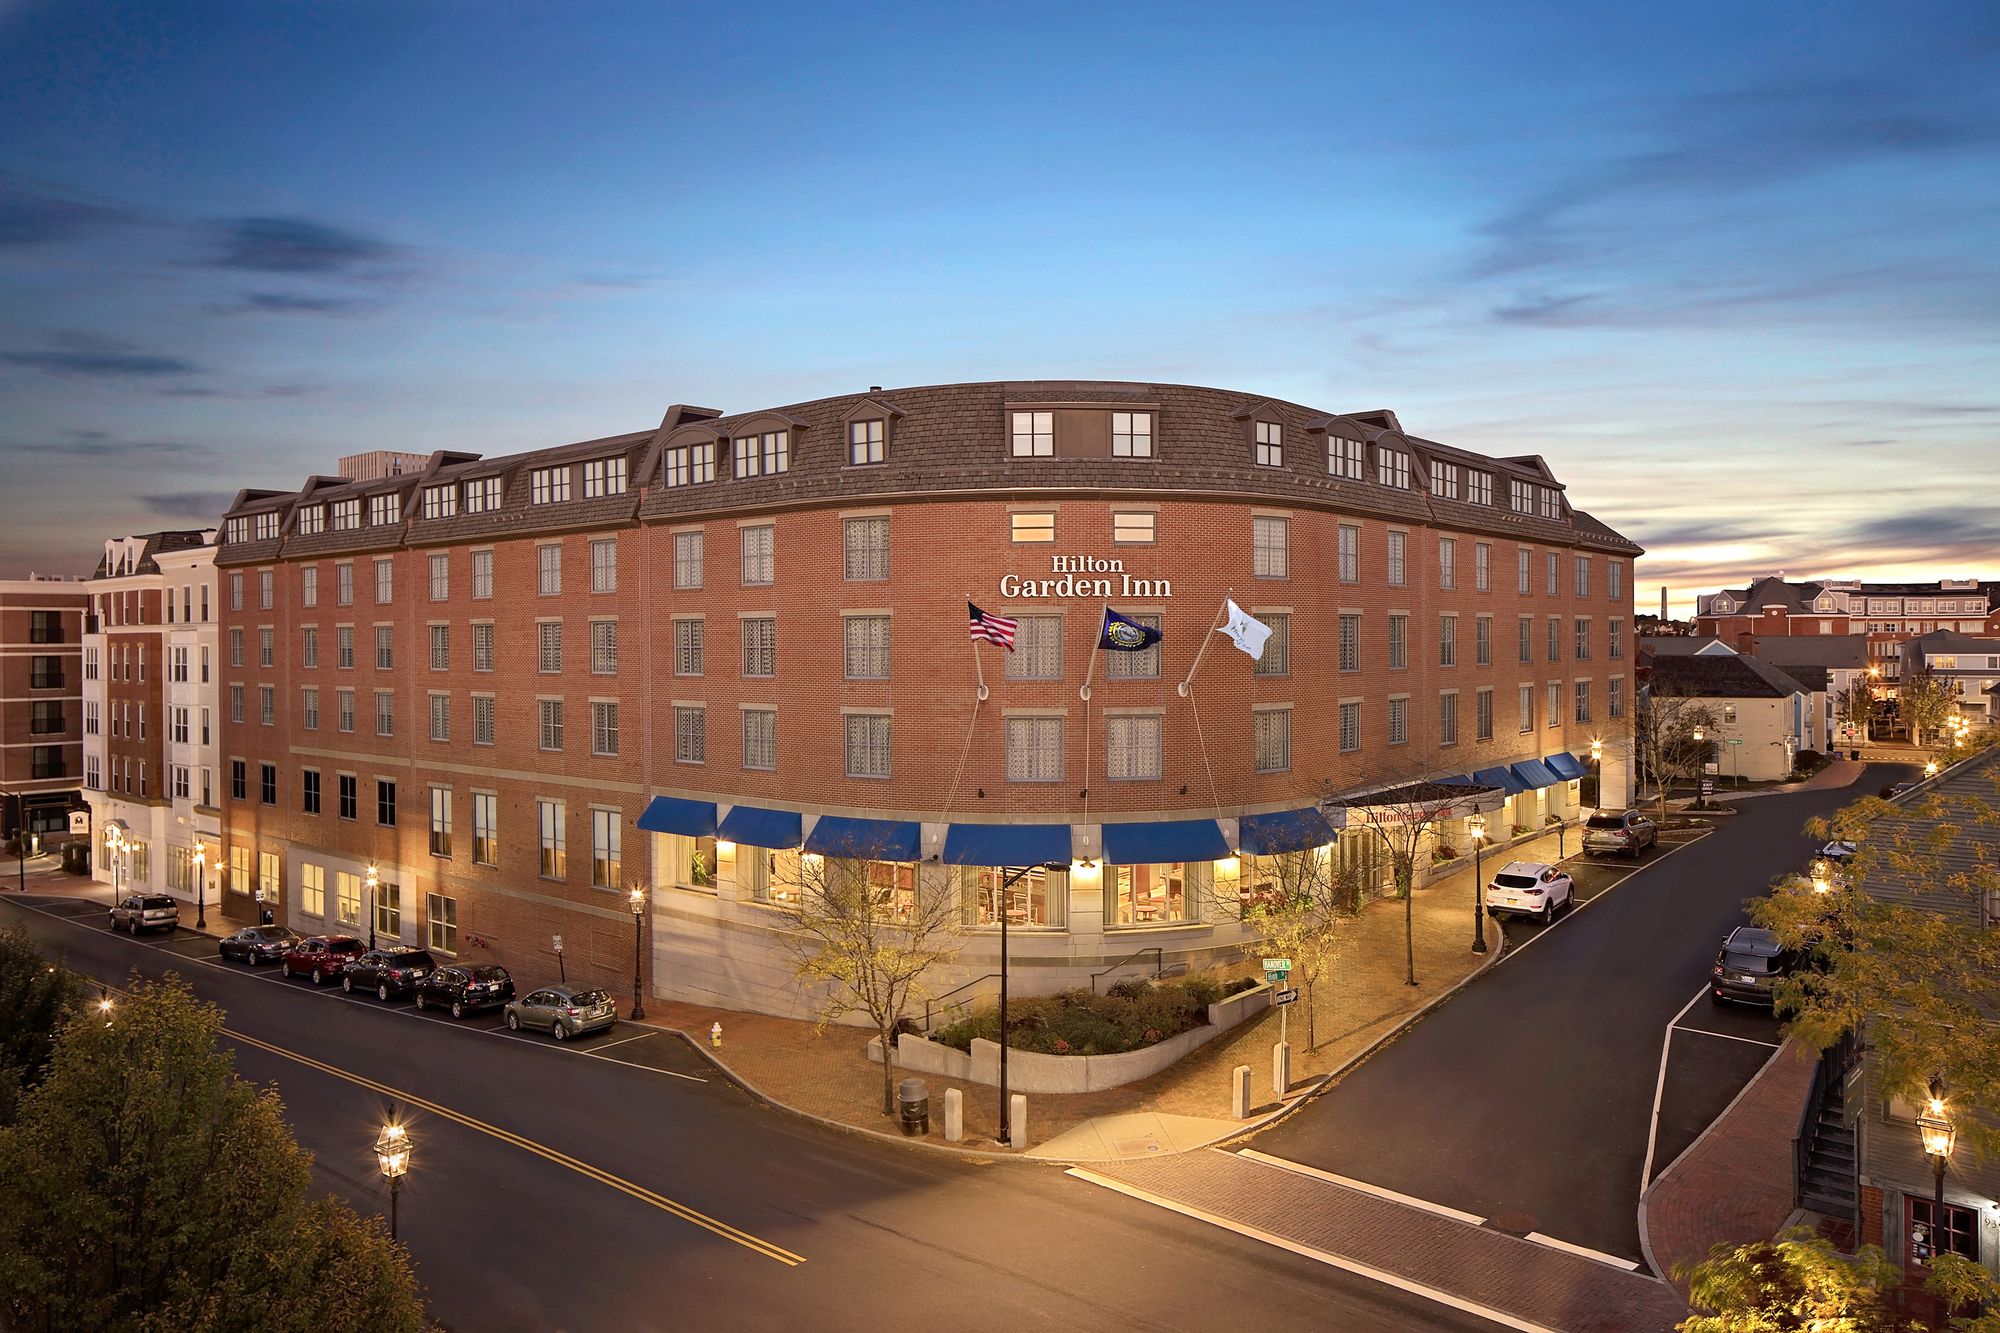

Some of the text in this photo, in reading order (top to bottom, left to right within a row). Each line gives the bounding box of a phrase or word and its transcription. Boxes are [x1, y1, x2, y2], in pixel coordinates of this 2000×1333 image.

[1052, 555, 1124, 573] Hilton
[1000, 574, 1172, 598] Garden Inn
[1366, 811, 1401, 823] Hilton
[1265, 960, 1285, 969] HANOVER
[1984, 1218, 1997, 1228] 93
